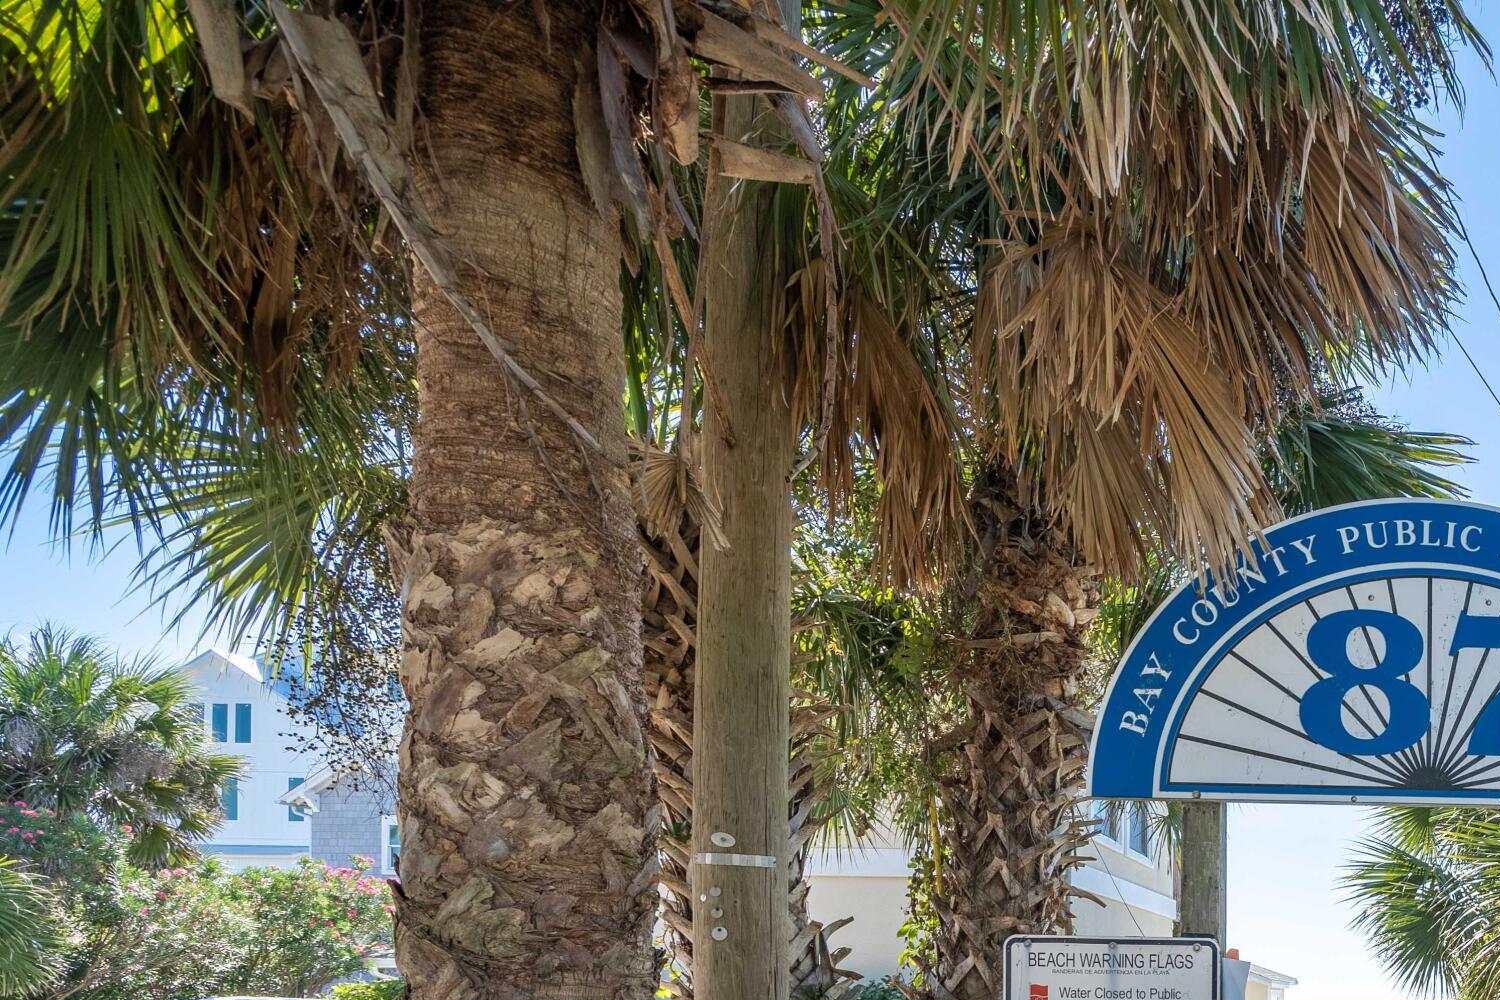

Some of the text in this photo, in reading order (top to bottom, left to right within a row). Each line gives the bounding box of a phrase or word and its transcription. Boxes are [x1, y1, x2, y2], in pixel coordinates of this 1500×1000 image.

[1119, 652, 1174, 738] BAY
[1172, 534, 1318, 646] COUNTY
[1337, 519, 1483, 553] PUBLIC
[1028, 952, 1194, 969] BEACH WARNING FLAGS
[1059, 987, 1182, 1000] Water Closed to Public
